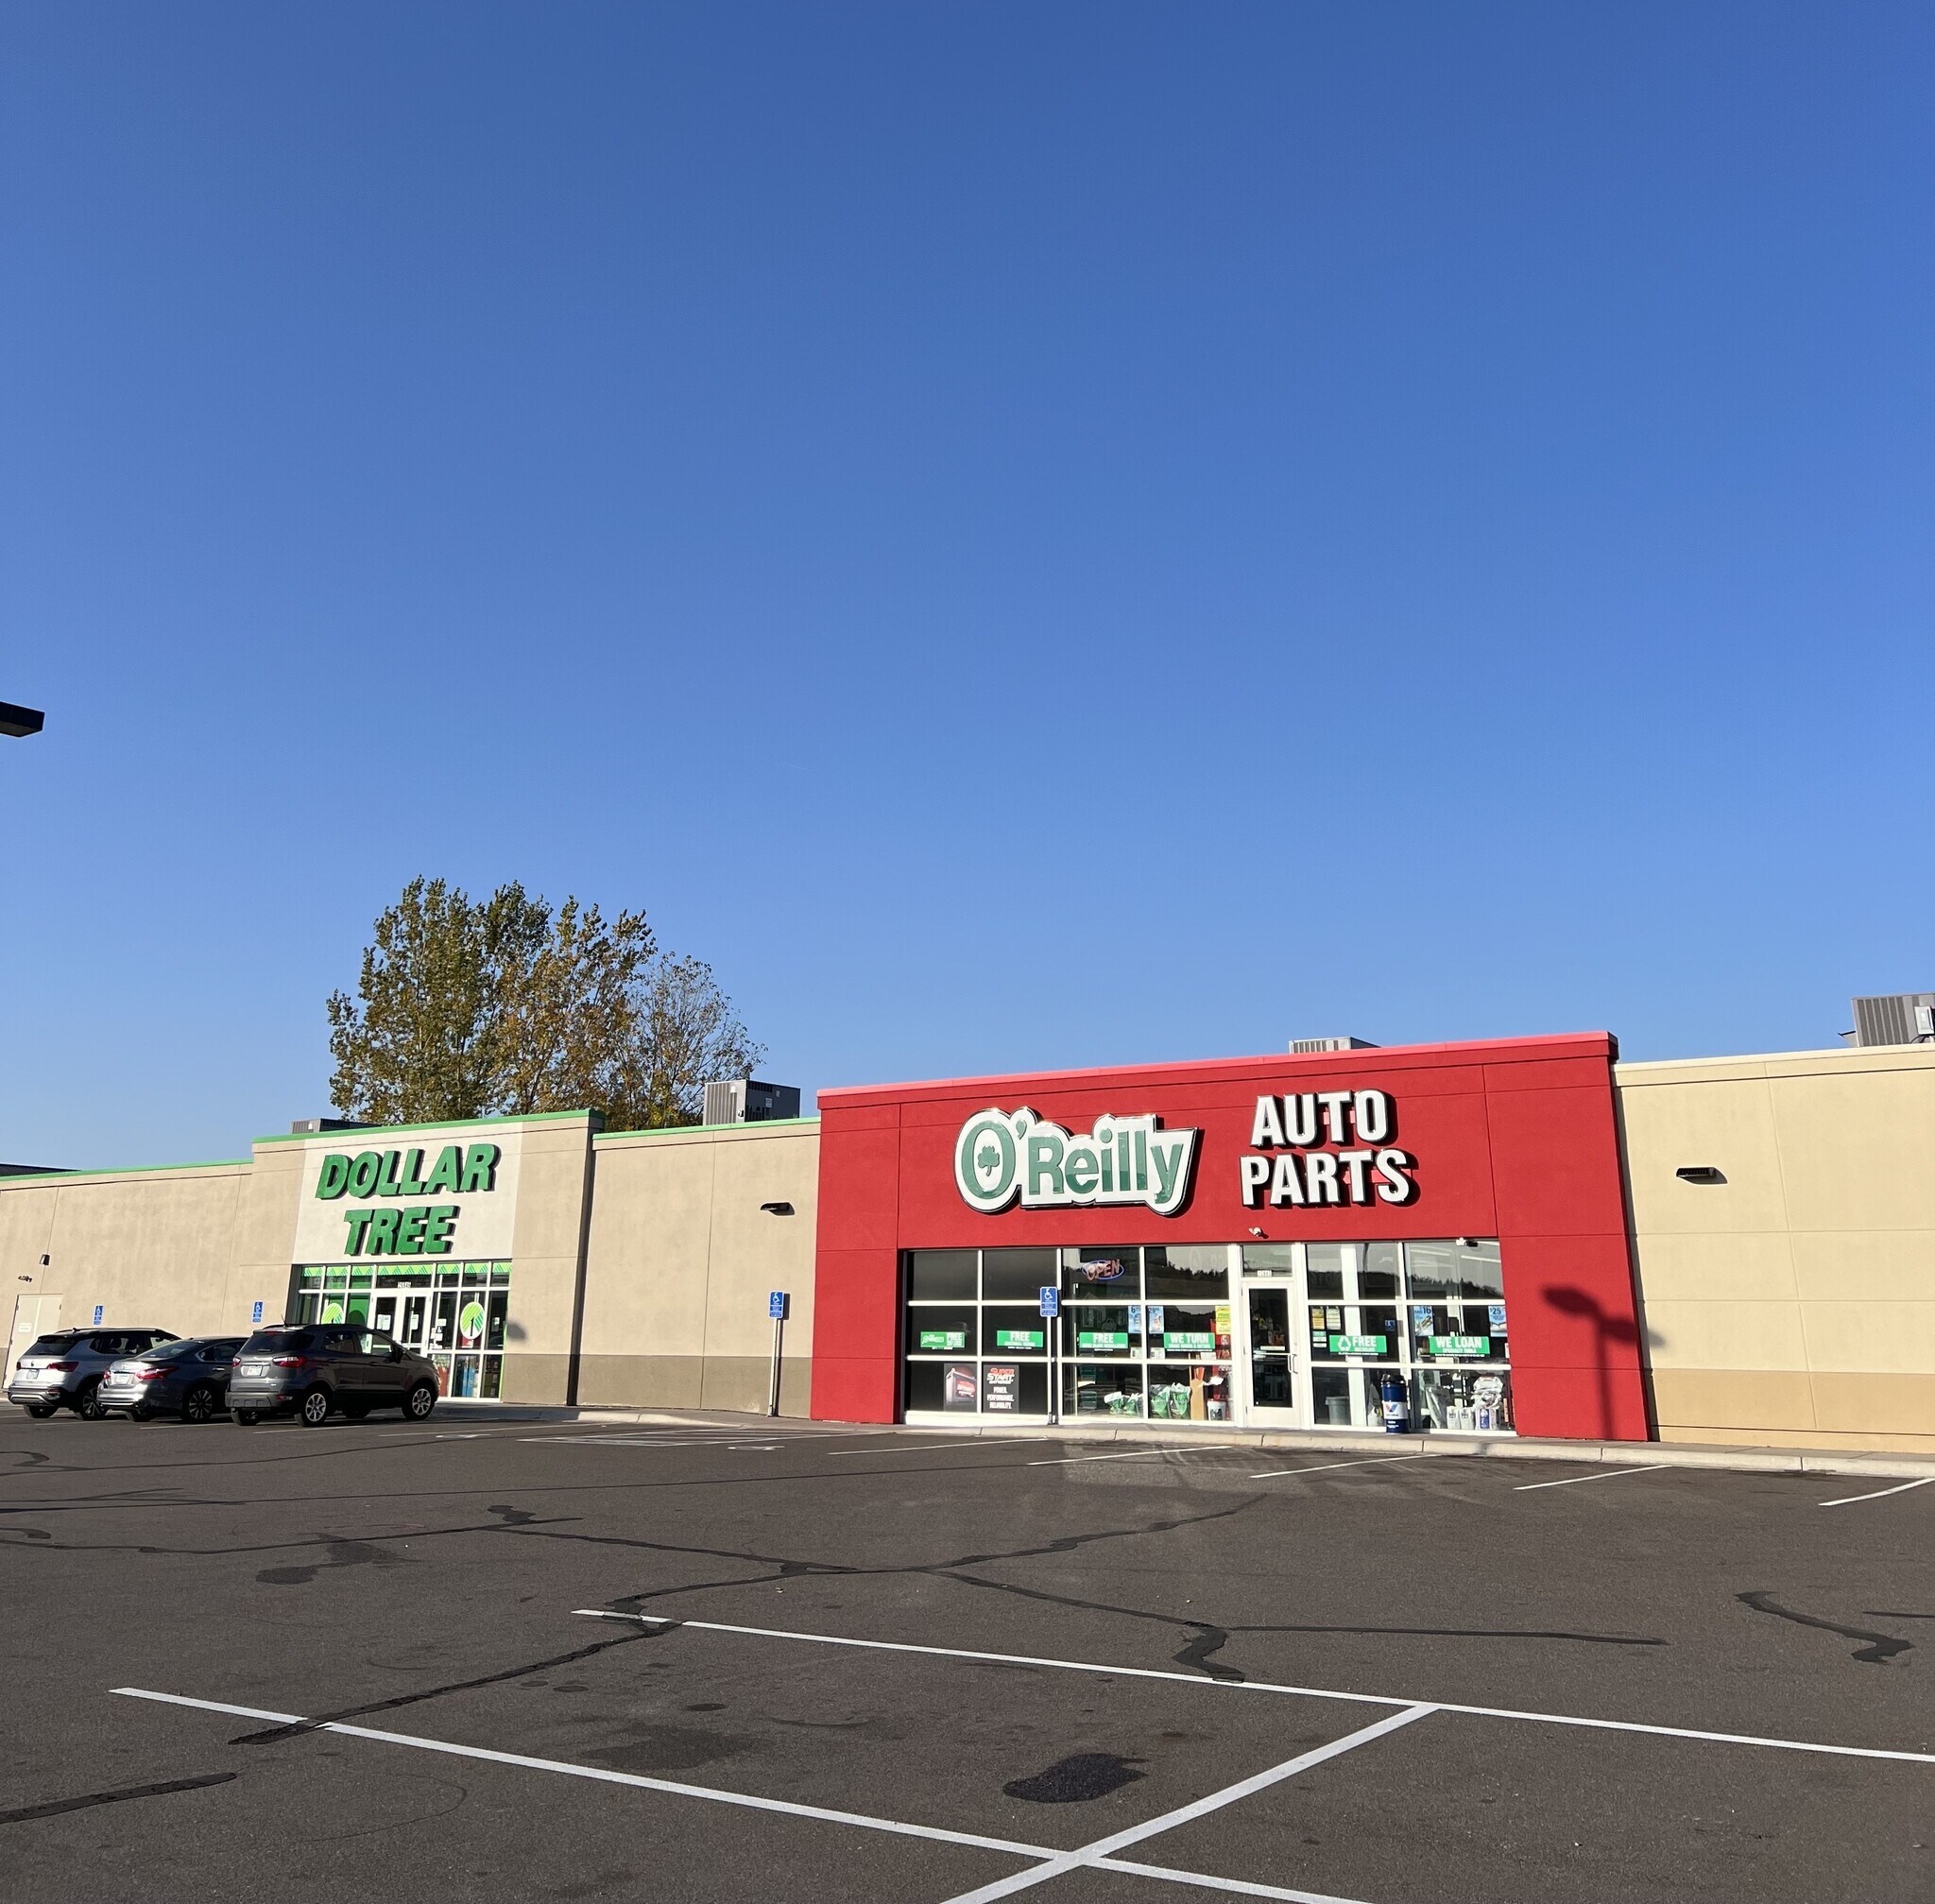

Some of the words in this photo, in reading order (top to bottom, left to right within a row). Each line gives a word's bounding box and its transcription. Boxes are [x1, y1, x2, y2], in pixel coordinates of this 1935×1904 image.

[1249, 1089, 1389, 1147] AUTO
[315, 1143, 499, 1199] DOLLAR
[959, 1117, 1186, 1205] O'Reilly
[1239, 1149, 1411, 1208] PARTS
[344, 1206, 457, 1255] TREE
[1086, 1259, 1121, 1281] OPEN
[1010, 1331, 1030, 1342] FREE
[1093, 1333, 1114, 1344] FREE
[1170, 1333, 1185, 1344] WE
[1186, 1333, 1208, 1344] TURN
[1353, 1336, 1377, 1347] FREE
[1435, 1336, 1452, 1348] WE
[1455, 1336, 1482, 1348] LOAN
